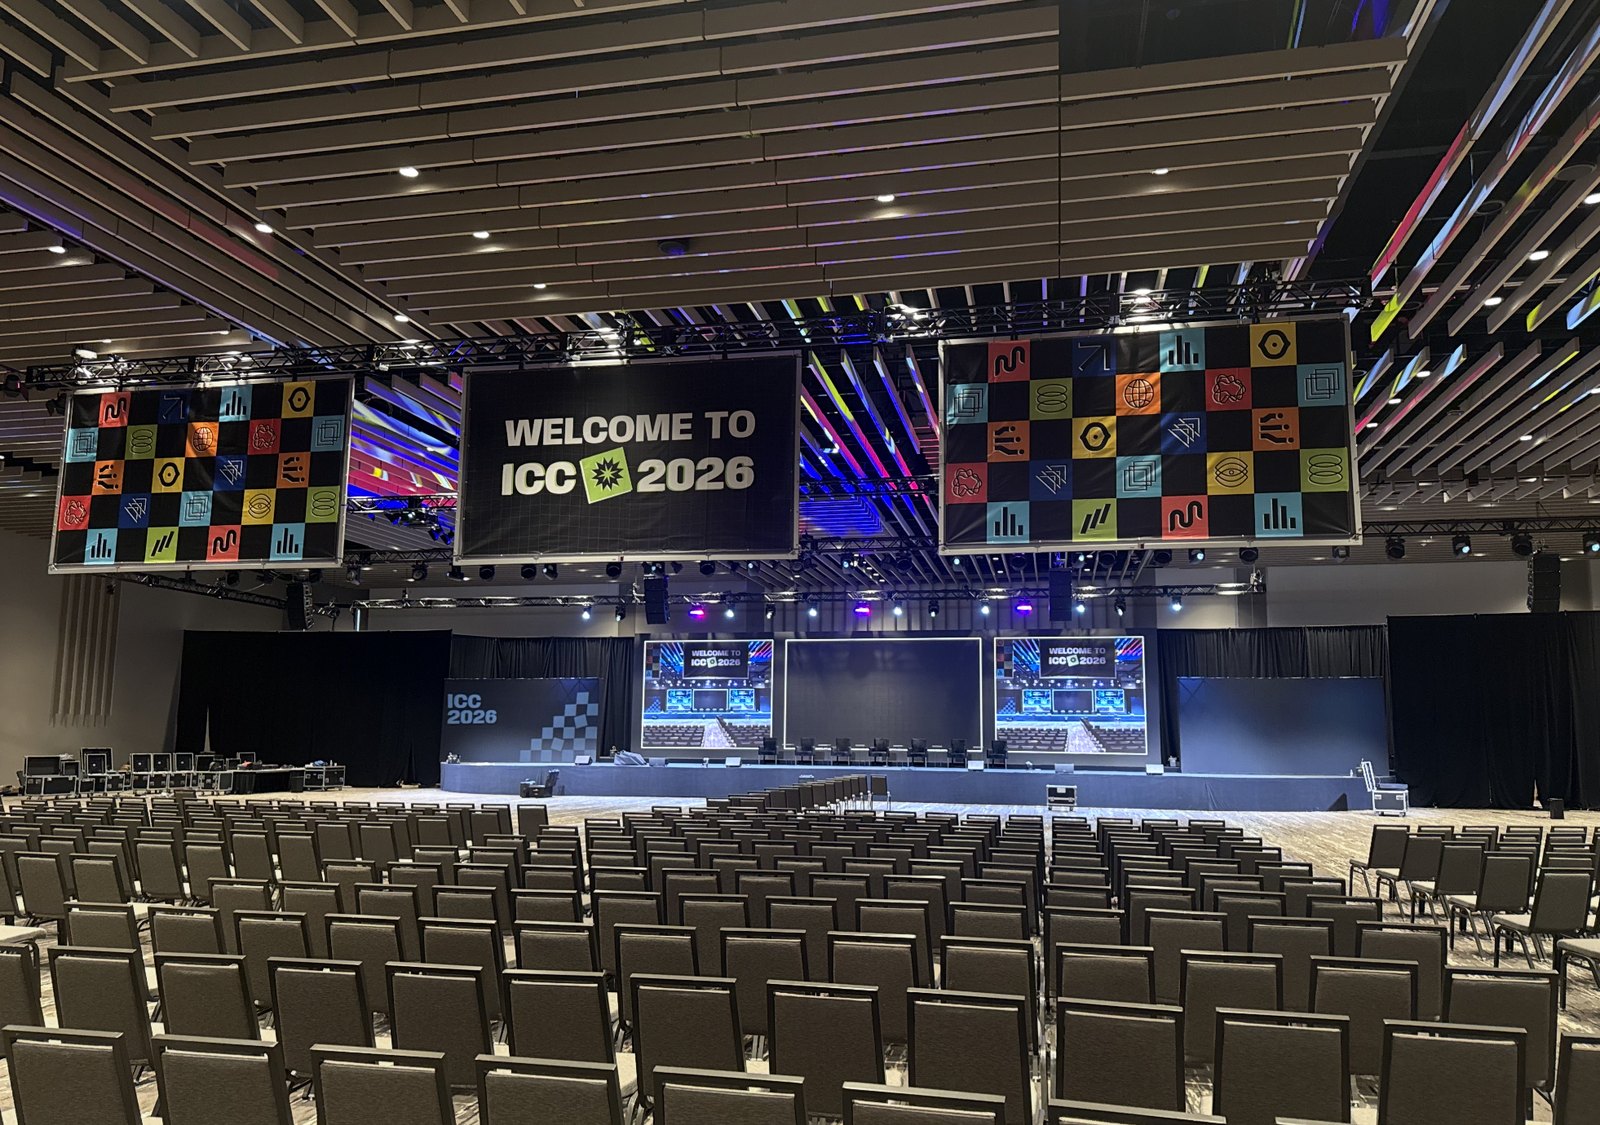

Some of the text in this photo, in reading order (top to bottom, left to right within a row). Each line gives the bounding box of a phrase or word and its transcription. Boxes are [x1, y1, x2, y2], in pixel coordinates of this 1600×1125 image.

[505, 409, 756, 447] WELCOME TO
[501, 455, 755, 496] ICC 2026
[691, 649, 741, 657] WELCOME TO
[1049, 656, 1106, 665] ICC 2026
[691, 658, 741, 667] ICC 2026
[447, 693, 482, 709] ICC
[447, 709, 498, 725] 2026
